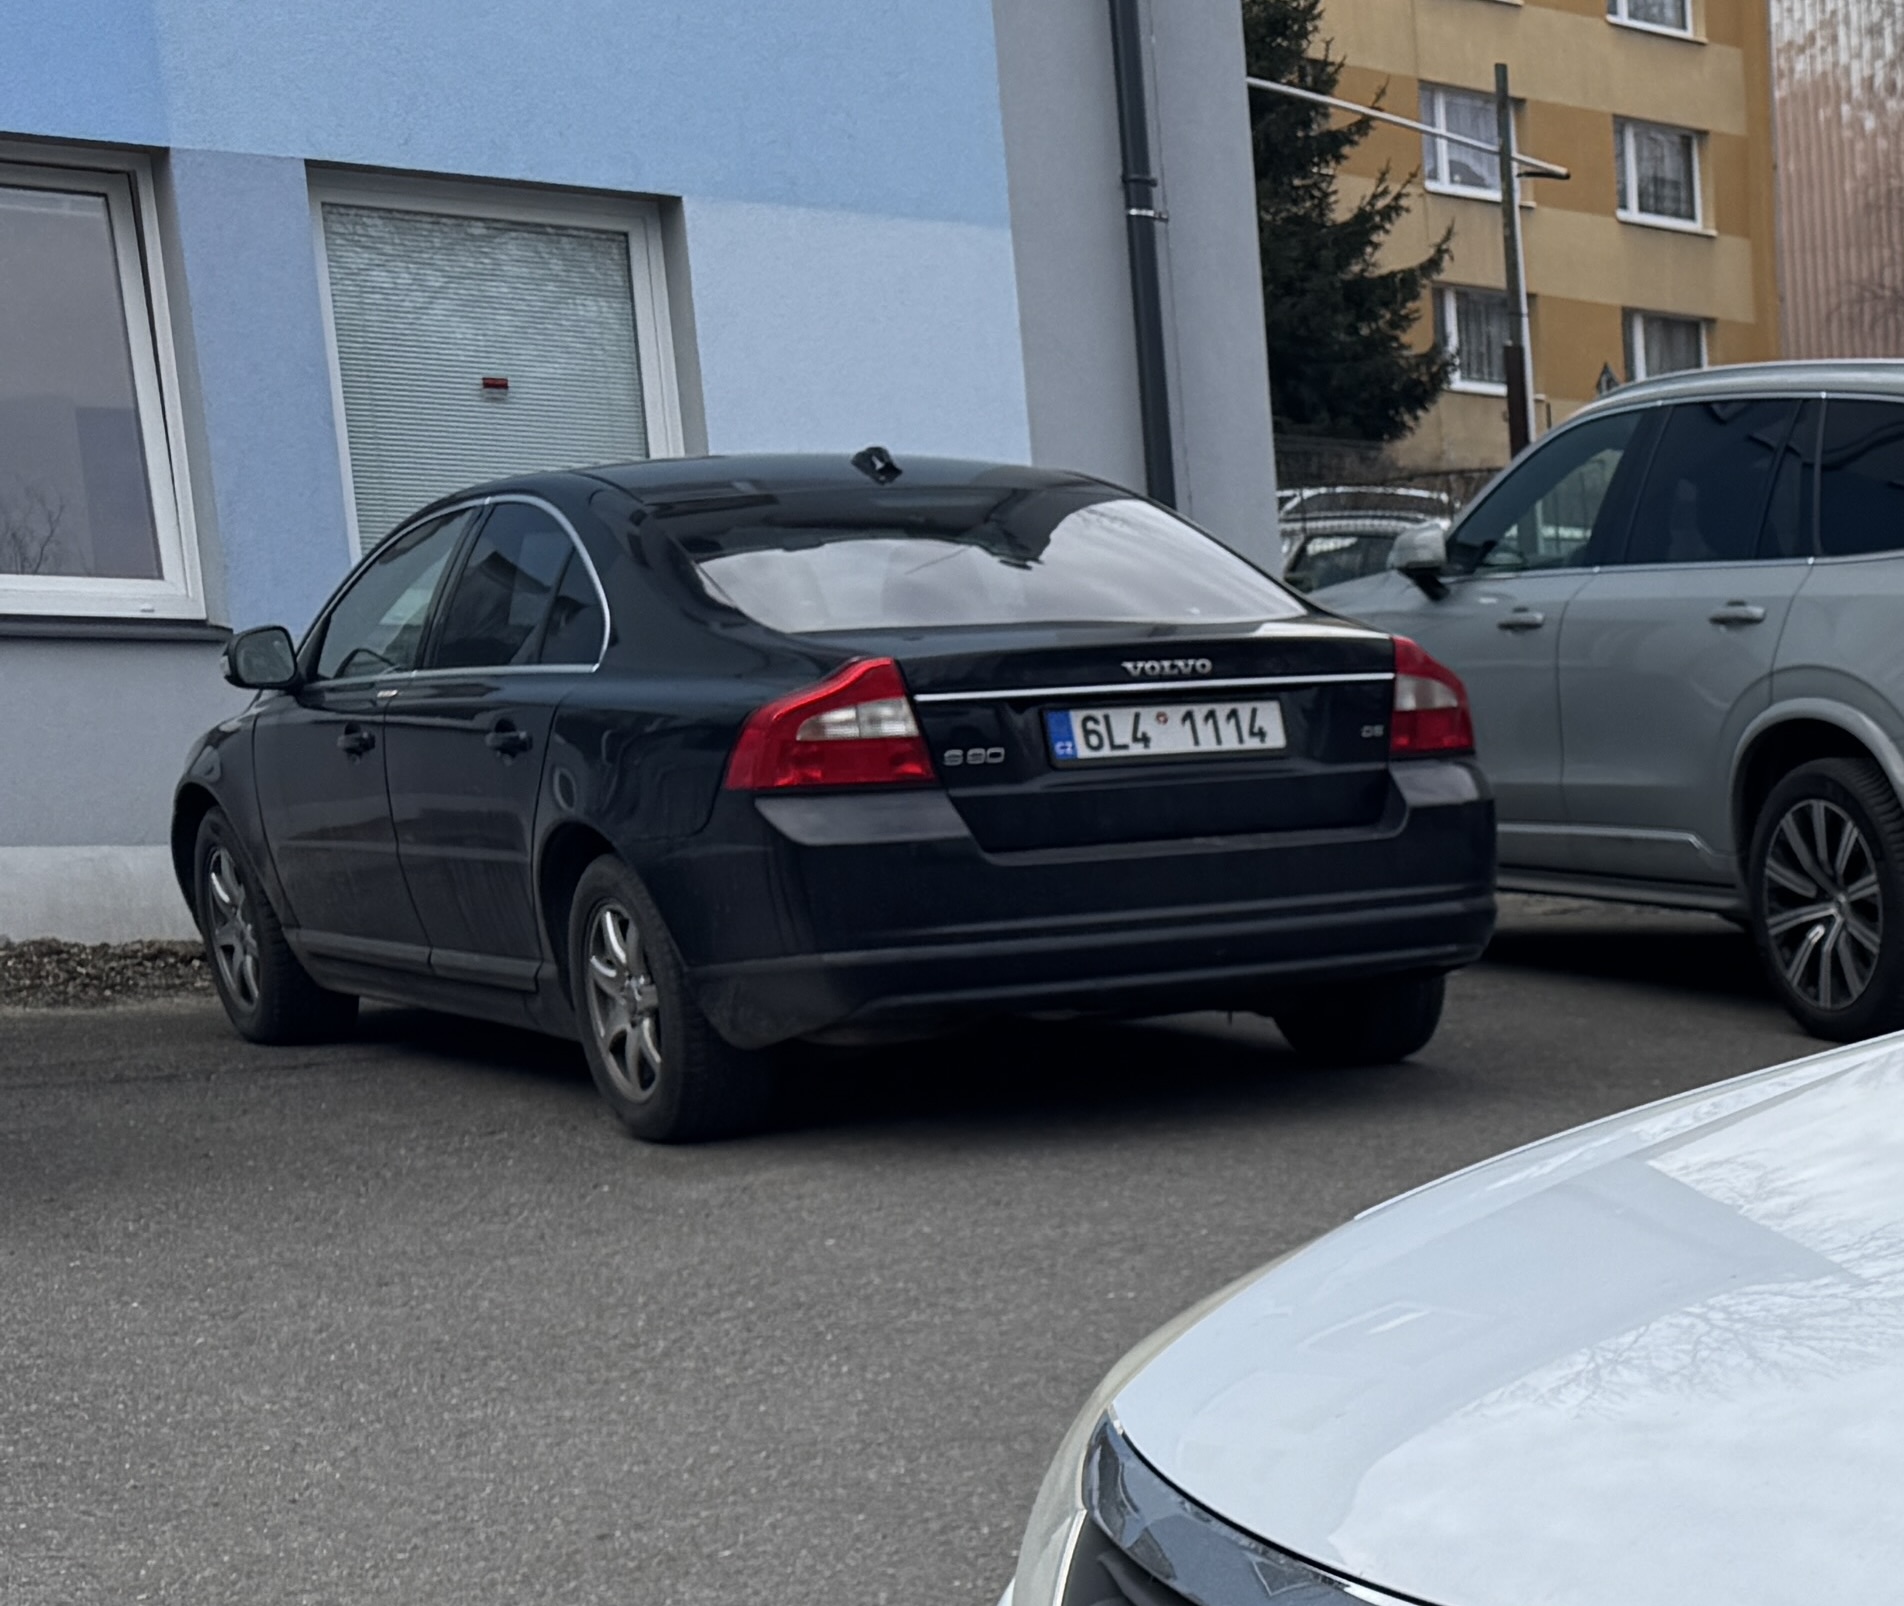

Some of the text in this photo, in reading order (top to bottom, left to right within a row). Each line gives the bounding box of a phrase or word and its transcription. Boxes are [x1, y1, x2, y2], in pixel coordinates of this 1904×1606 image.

[1121, 658, 1213, 676] VOLVO
[1081, 707, 1268, 752] 6L4 1114
[1055, 742, 1074, 754] CZ
